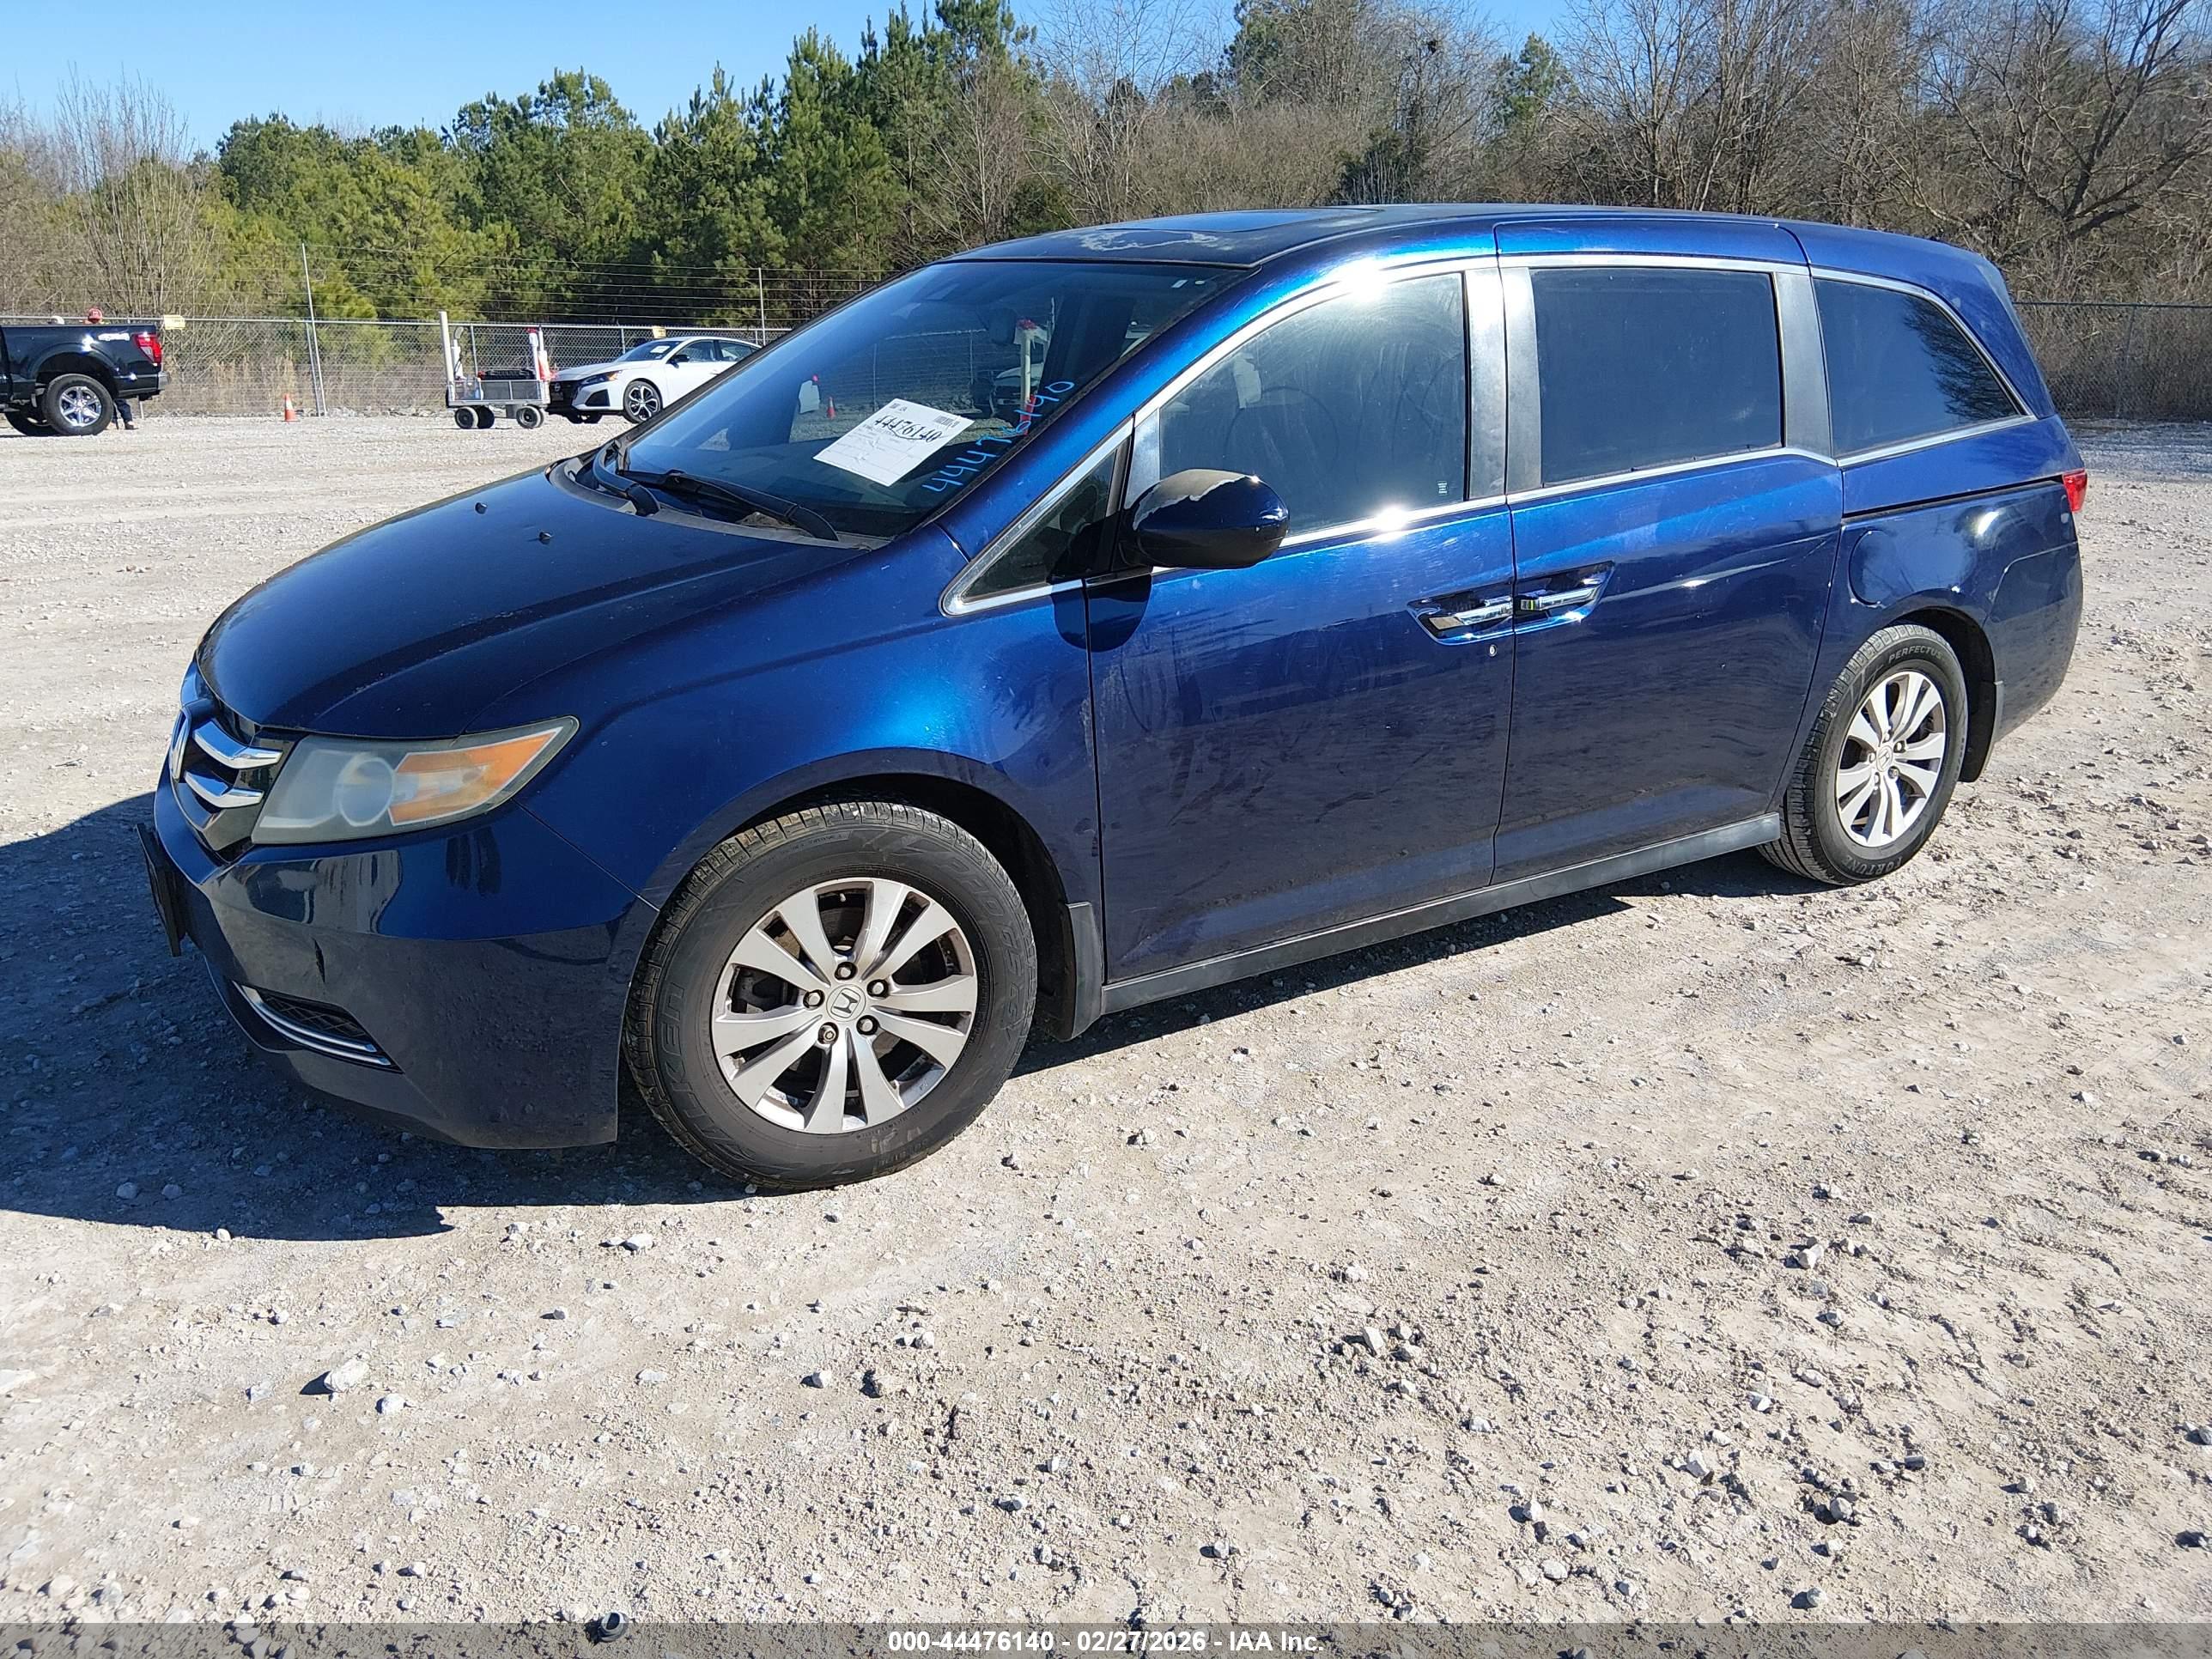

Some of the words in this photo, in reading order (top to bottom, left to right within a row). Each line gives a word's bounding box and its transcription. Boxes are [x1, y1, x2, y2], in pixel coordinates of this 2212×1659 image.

[874, 415, 943, 443] 44476140
[1887, 645, 1943, 664] PERFECTUS
[1840, 854, 1904, 877] FORTUNE
[660, 982, 757, 1161] FALKEN
